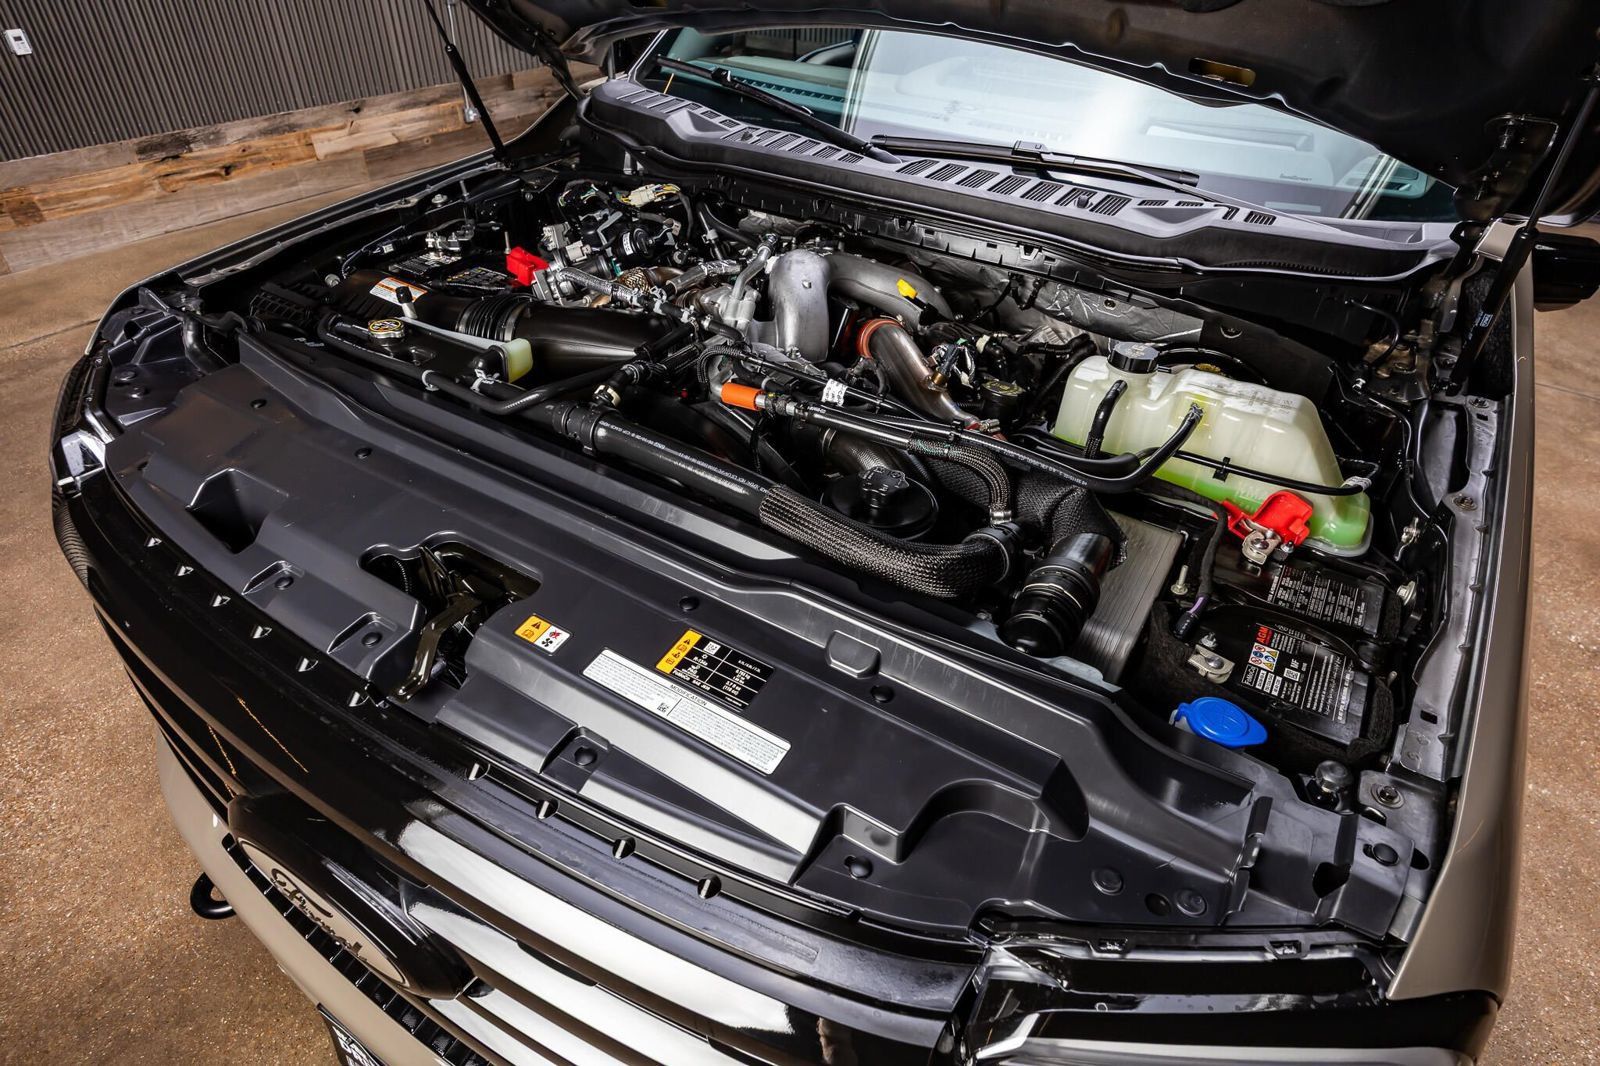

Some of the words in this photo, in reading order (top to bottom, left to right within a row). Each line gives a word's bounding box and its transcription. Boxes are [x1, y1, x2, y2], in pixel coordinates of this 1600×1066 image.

[1256, 626, 1269, 643] AGM
[1245, 666, 1256, 686] FoMoCo
[670, 684, 707, 706] MODIFICATION
